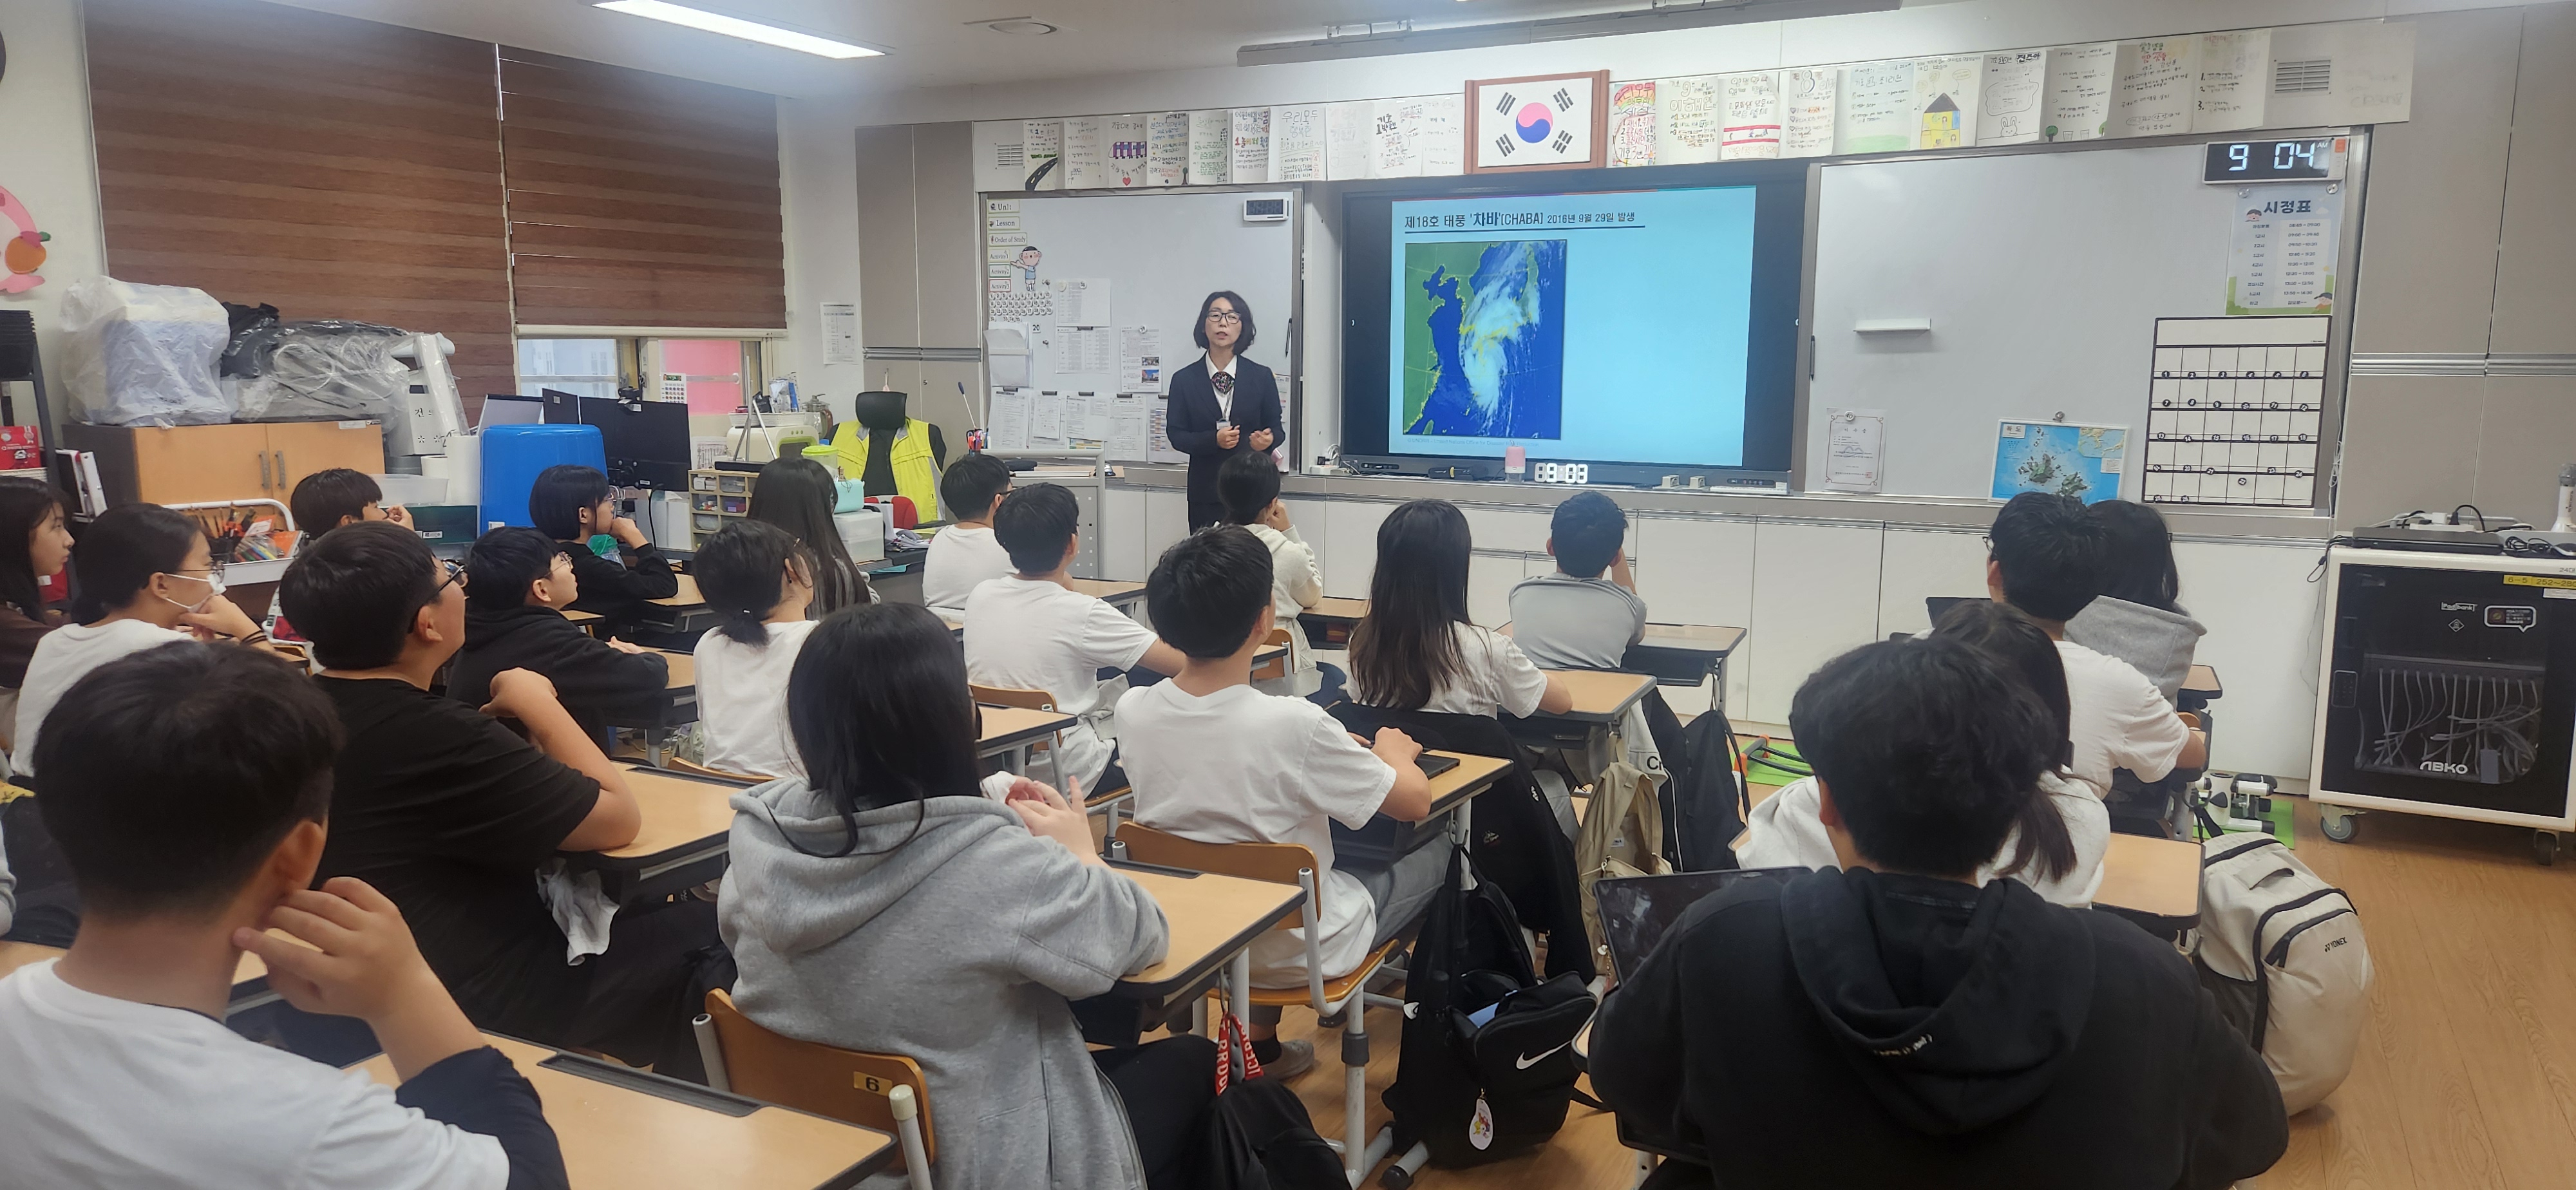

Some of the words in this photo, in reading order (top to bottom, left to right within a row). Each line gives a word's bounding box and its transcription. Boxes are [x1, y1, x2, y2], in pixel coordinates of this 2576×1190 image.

[1282, 110, 1318, 122] 우리모두
[2229, 144, 2249, 171] 9
[2273, 142, 2315, 169] 04
[2264, 200, 2311, 214] 시정표
[1405, 216, 1439, 228] 제18호
[1444, 214, 1466, 227] 태풍
[1547, 214, 1575, 223] 2016년
[1578, 213, 1592, 223] 9월
[1595, 212, 1614, 222] 29일
[1618, 212, 1635, 222] 발생
[2420, 761, 2468, 775] ABKO
[2329, 936, 2347, 949] YONEX
[866, 1077, 880, 1091] 6
